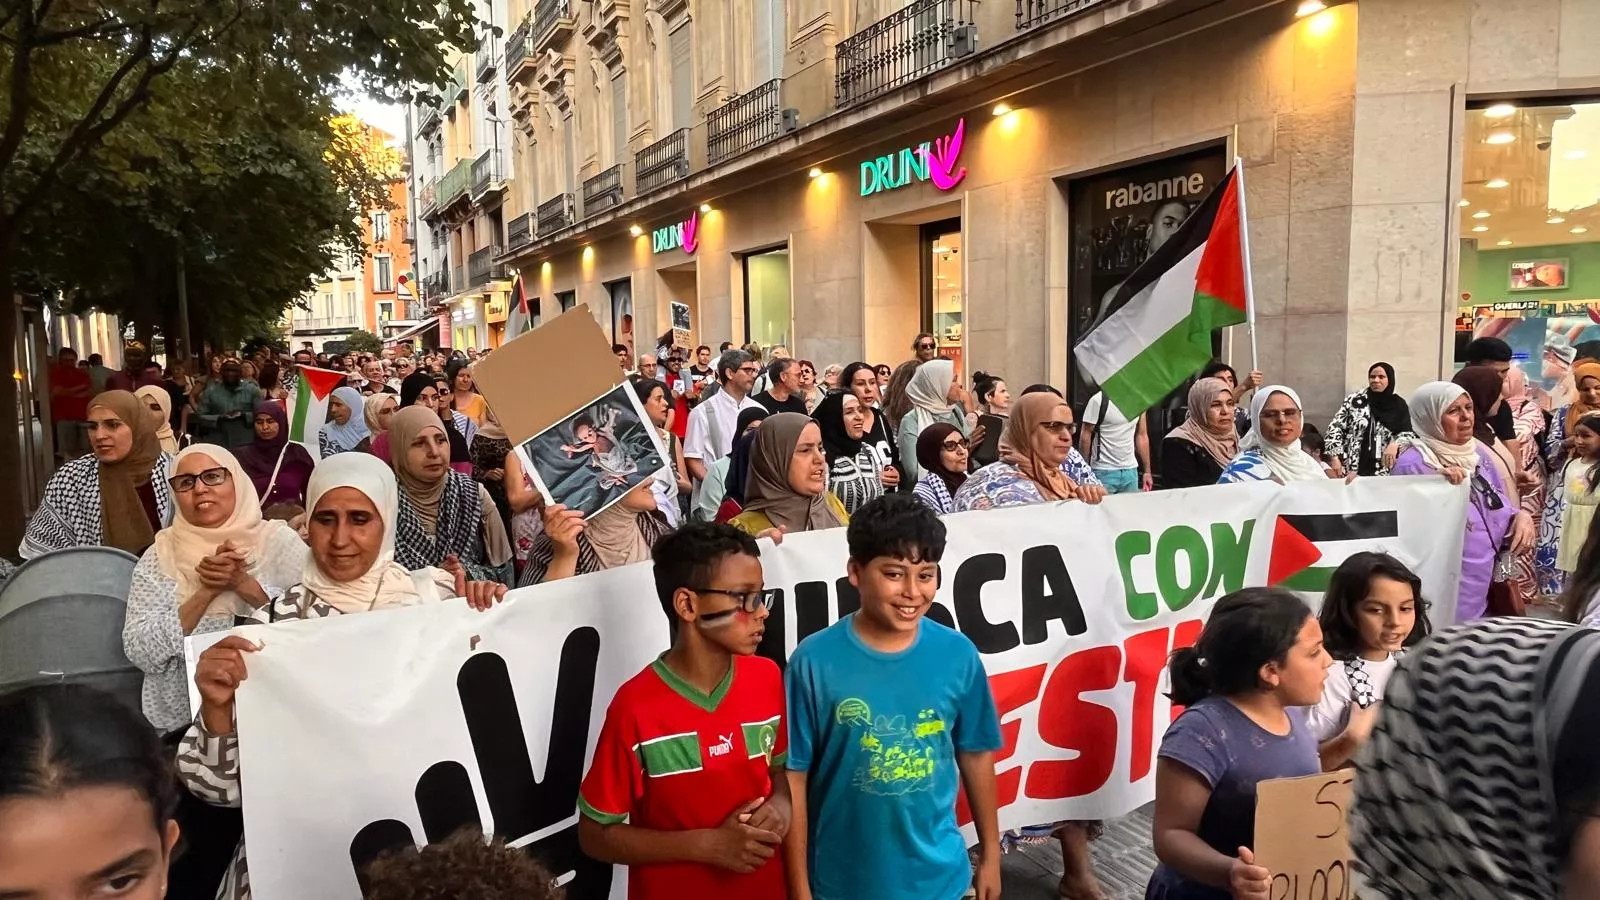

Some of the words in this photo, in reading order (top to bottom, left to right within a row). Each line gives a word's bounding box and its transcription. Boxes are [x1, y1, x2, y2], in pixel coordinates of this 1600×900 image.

[860, 141, 930, 197] DRUNI
[1105, 172, 1204, 210] rabanne
[652, 221, 684, 254] DRUNI
[1115, 518, 1257, 621] CON
[708, 743, 730, 758] PUMA
